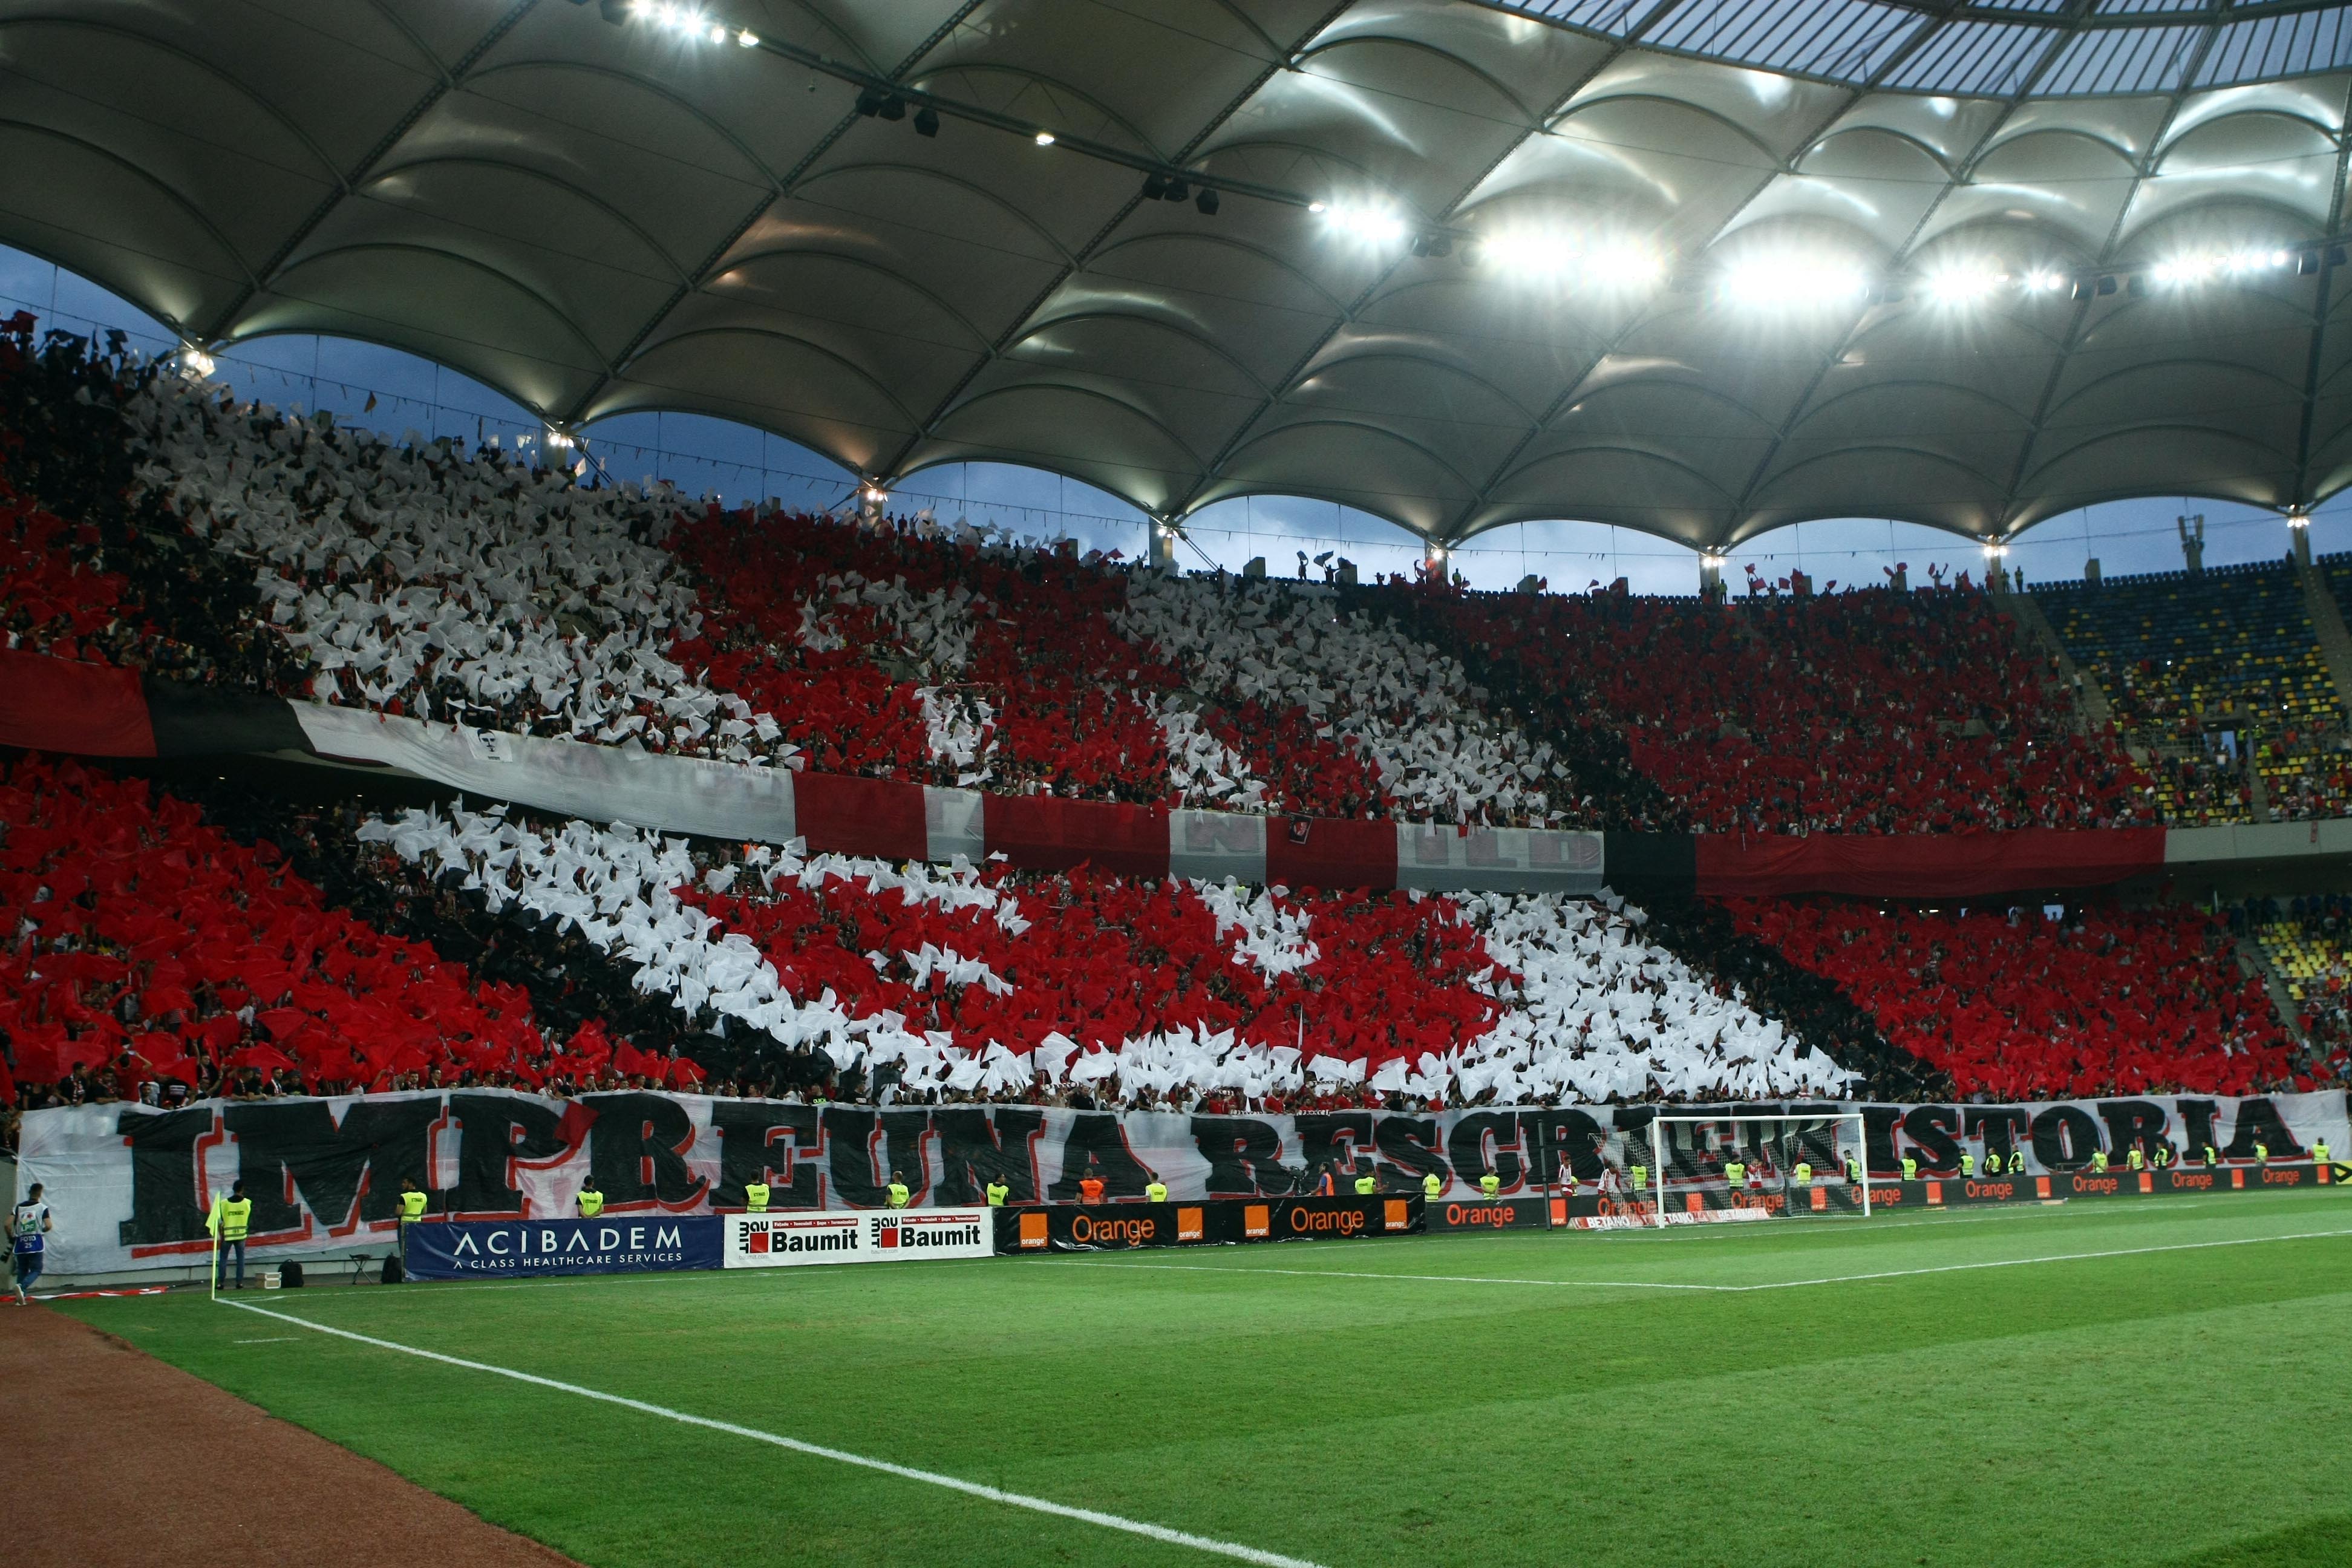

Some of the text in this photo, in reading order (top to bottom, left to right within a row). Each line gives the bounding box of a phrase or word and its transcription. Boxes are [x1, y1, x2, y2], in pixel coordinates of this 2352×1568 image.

[1859, 1097, 2308, 1177] ISTORIA
[2073, 1175, 2118, 1195] Orange
[2172, 1171, 2213, 1191] Orange
[2262, 1168, 2300, 1186] Orange
[1851, 1185, 1901, 1207] Oange
[1965, 1180, 2013, 1201] Orange
[1732, 1191, 1784, 1214] Orange
[1291, 1207, 1364, 1235] Orange
[1446, 1203, 1515, 1228] Orange
[454, 1225, 682, 1256] ACIBADEM
[772, 1229, 858, 1253] Baumit
[901, 1225, 981, 1247] Baumit
[1072, 1215, 1155, 1247] Orange
[471, 1259, 515, 1269] CLASS
[523, 1255, 612, 1267] HEALTHCARE
[619, 1252, 682, 1263] SERVICES
